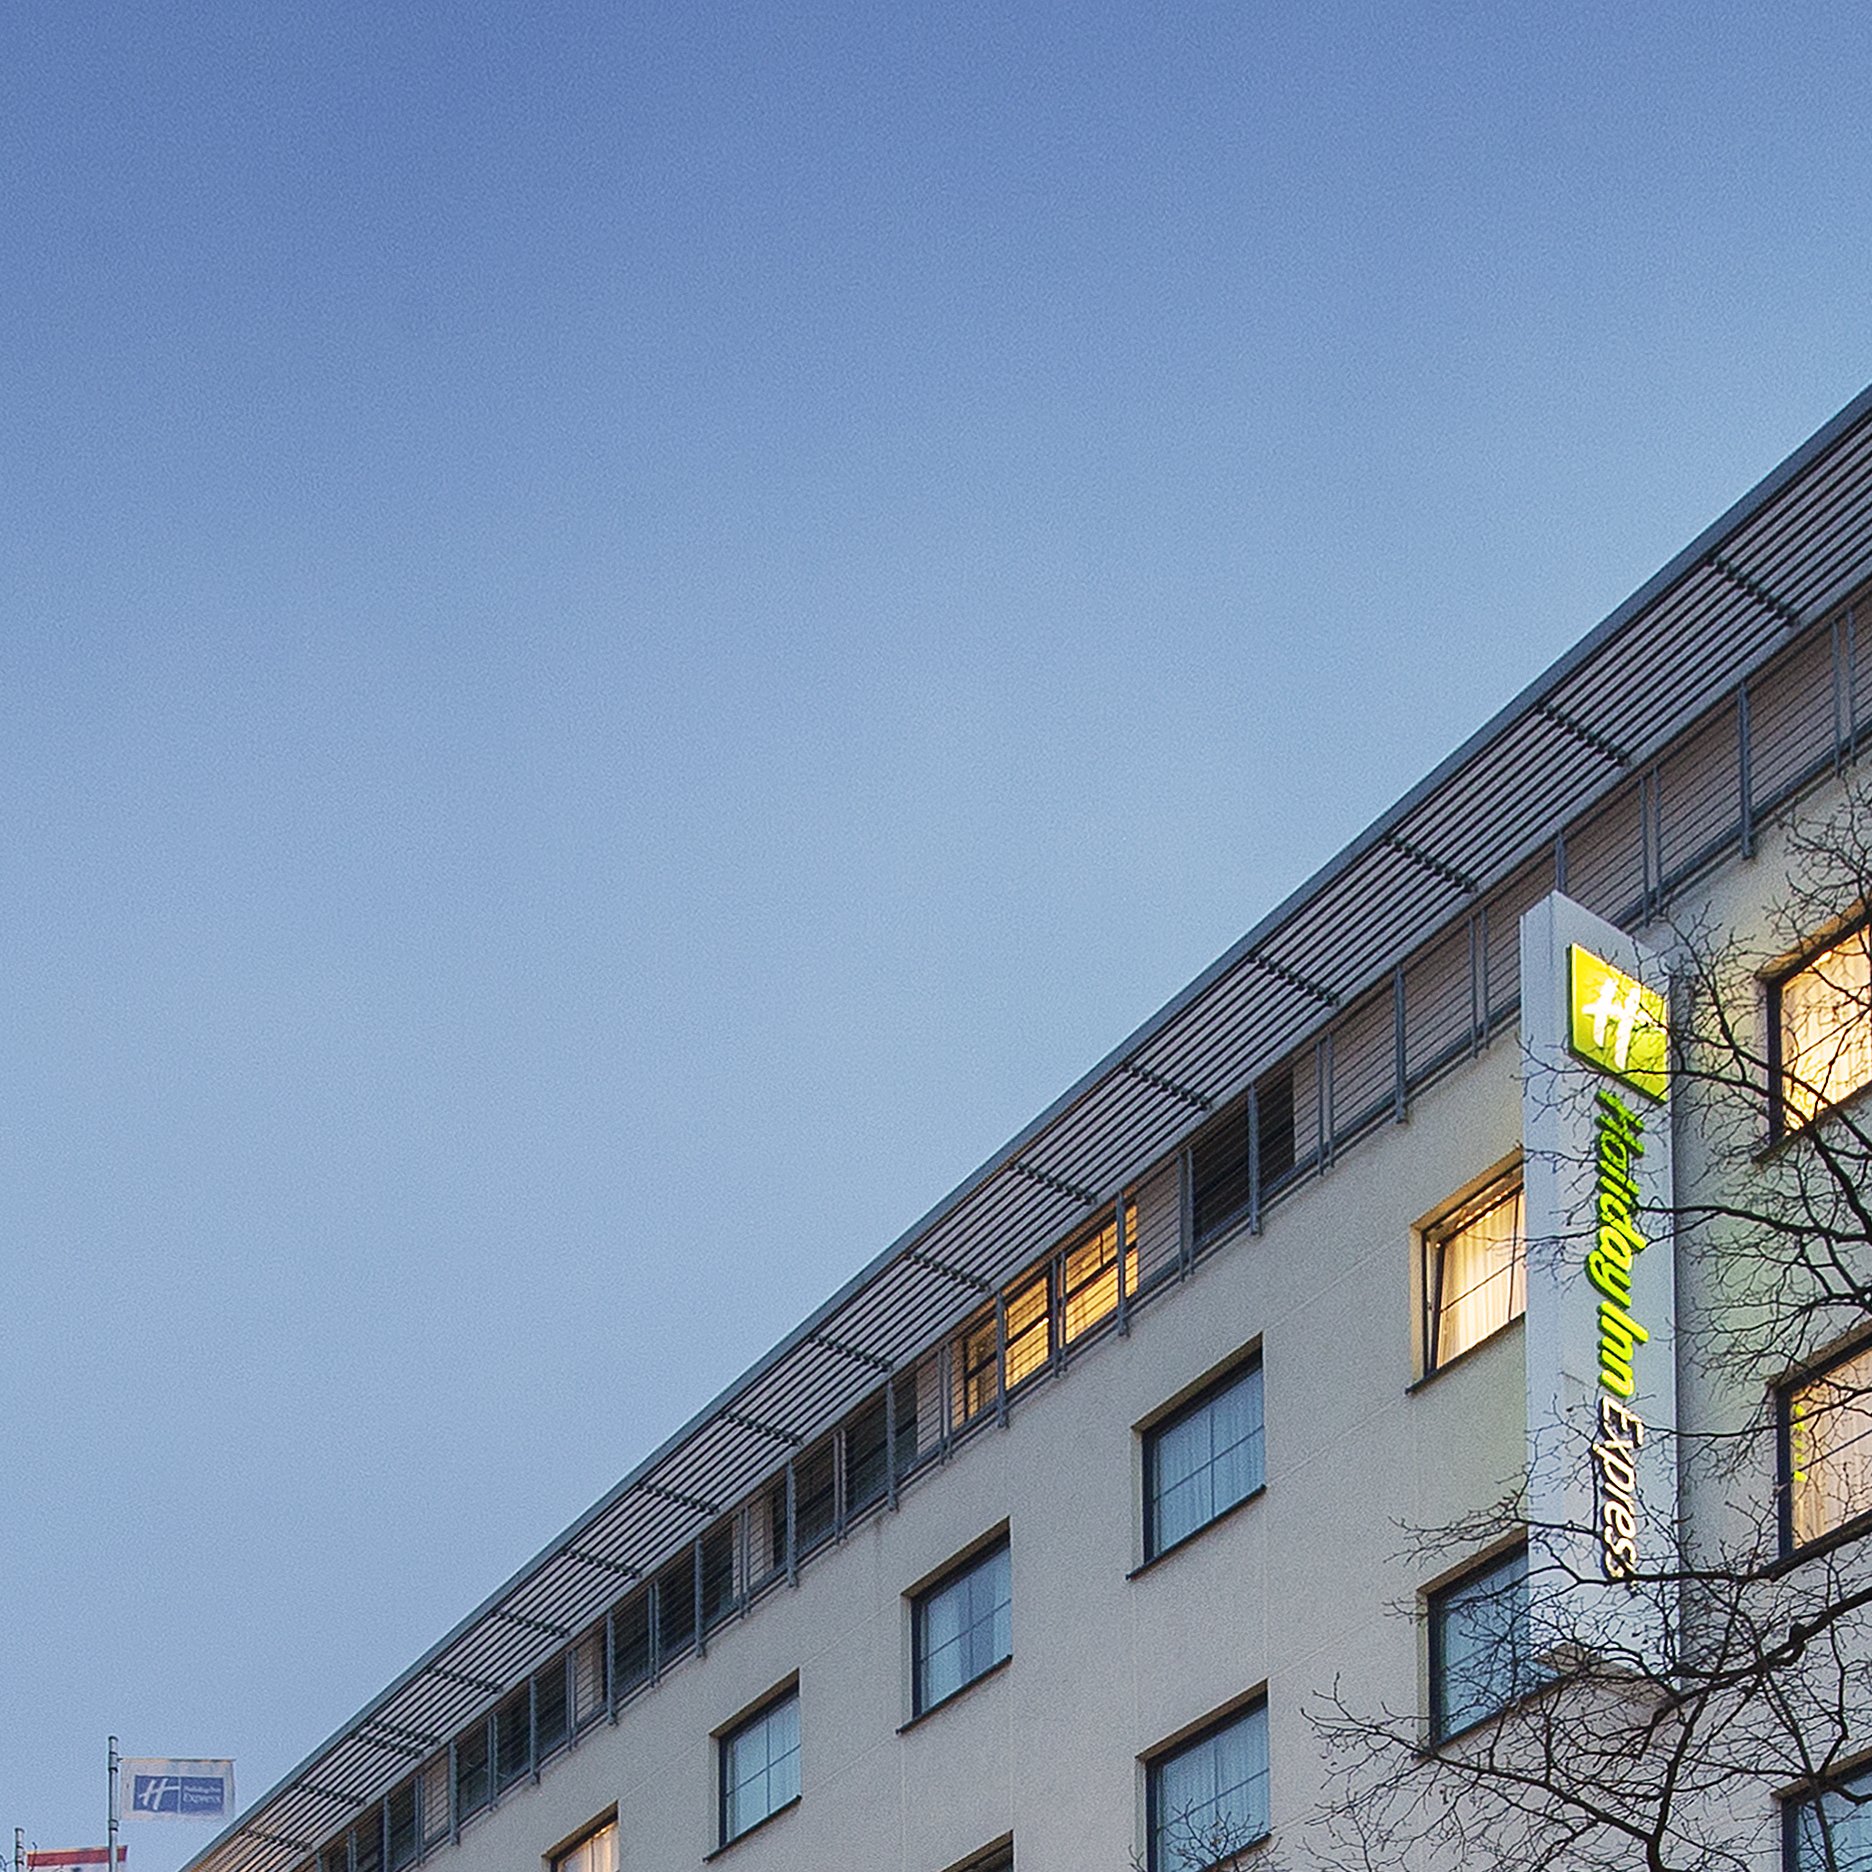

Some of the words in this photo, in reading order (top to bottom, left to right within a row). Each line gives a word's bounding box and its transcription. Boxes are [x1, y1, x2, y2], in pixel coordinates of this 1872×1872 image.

[1586, 1088, 1646, 1303] Holiday
[1599, 1301, 1649, 1397] Inn
[1593, 1396, 1644, 1580] Express
